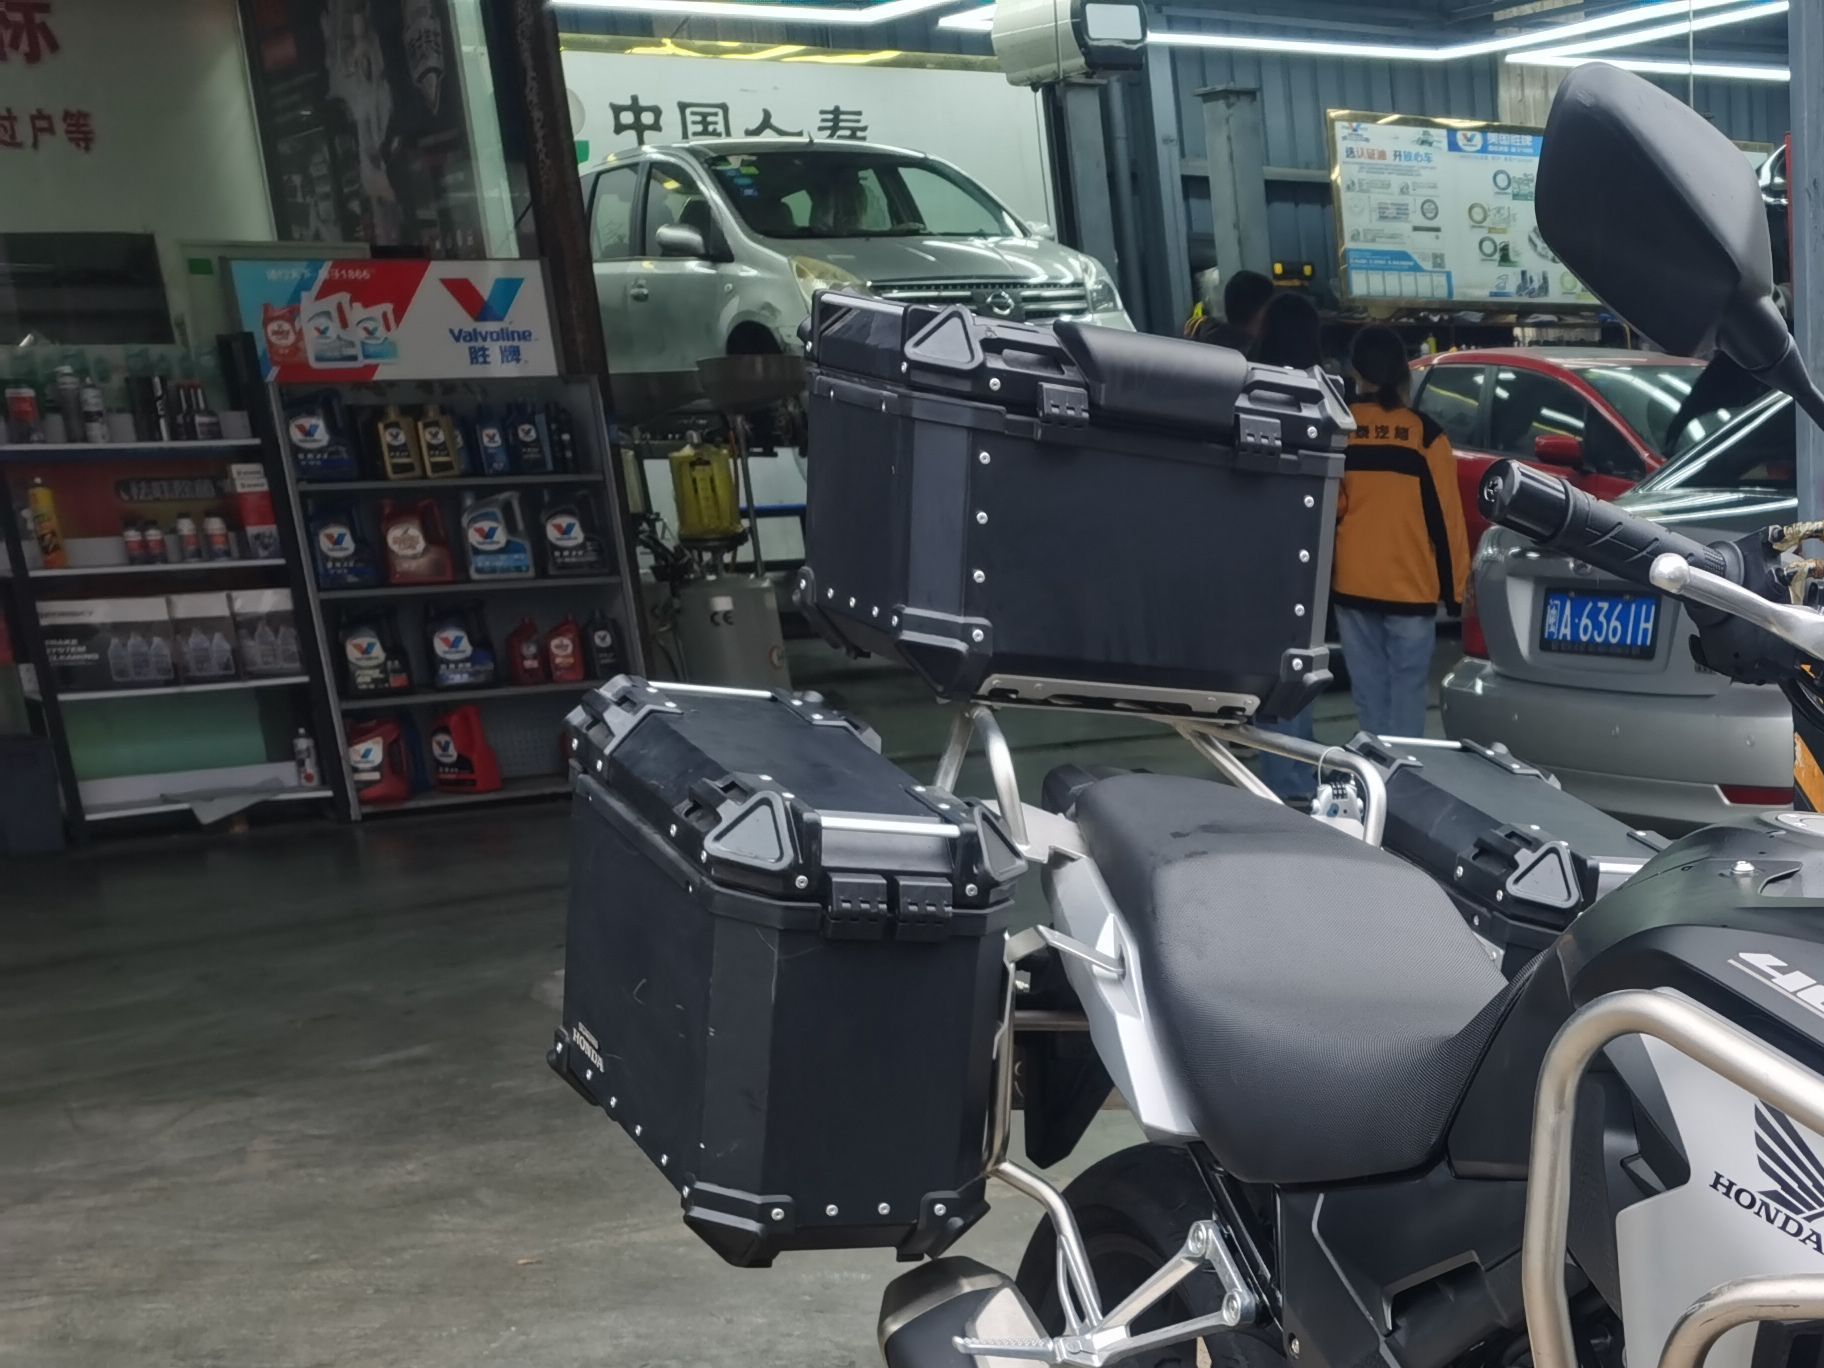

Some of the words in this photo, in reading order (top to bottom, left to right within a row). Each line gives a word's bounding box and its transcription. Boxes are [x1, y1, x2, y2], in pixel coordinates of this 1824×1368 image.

[449, 327, 533, 344] Valvoline
[572, 1026, 605, 1073] HONDA
[1709, 1171, 1824, 1256] HONDA
